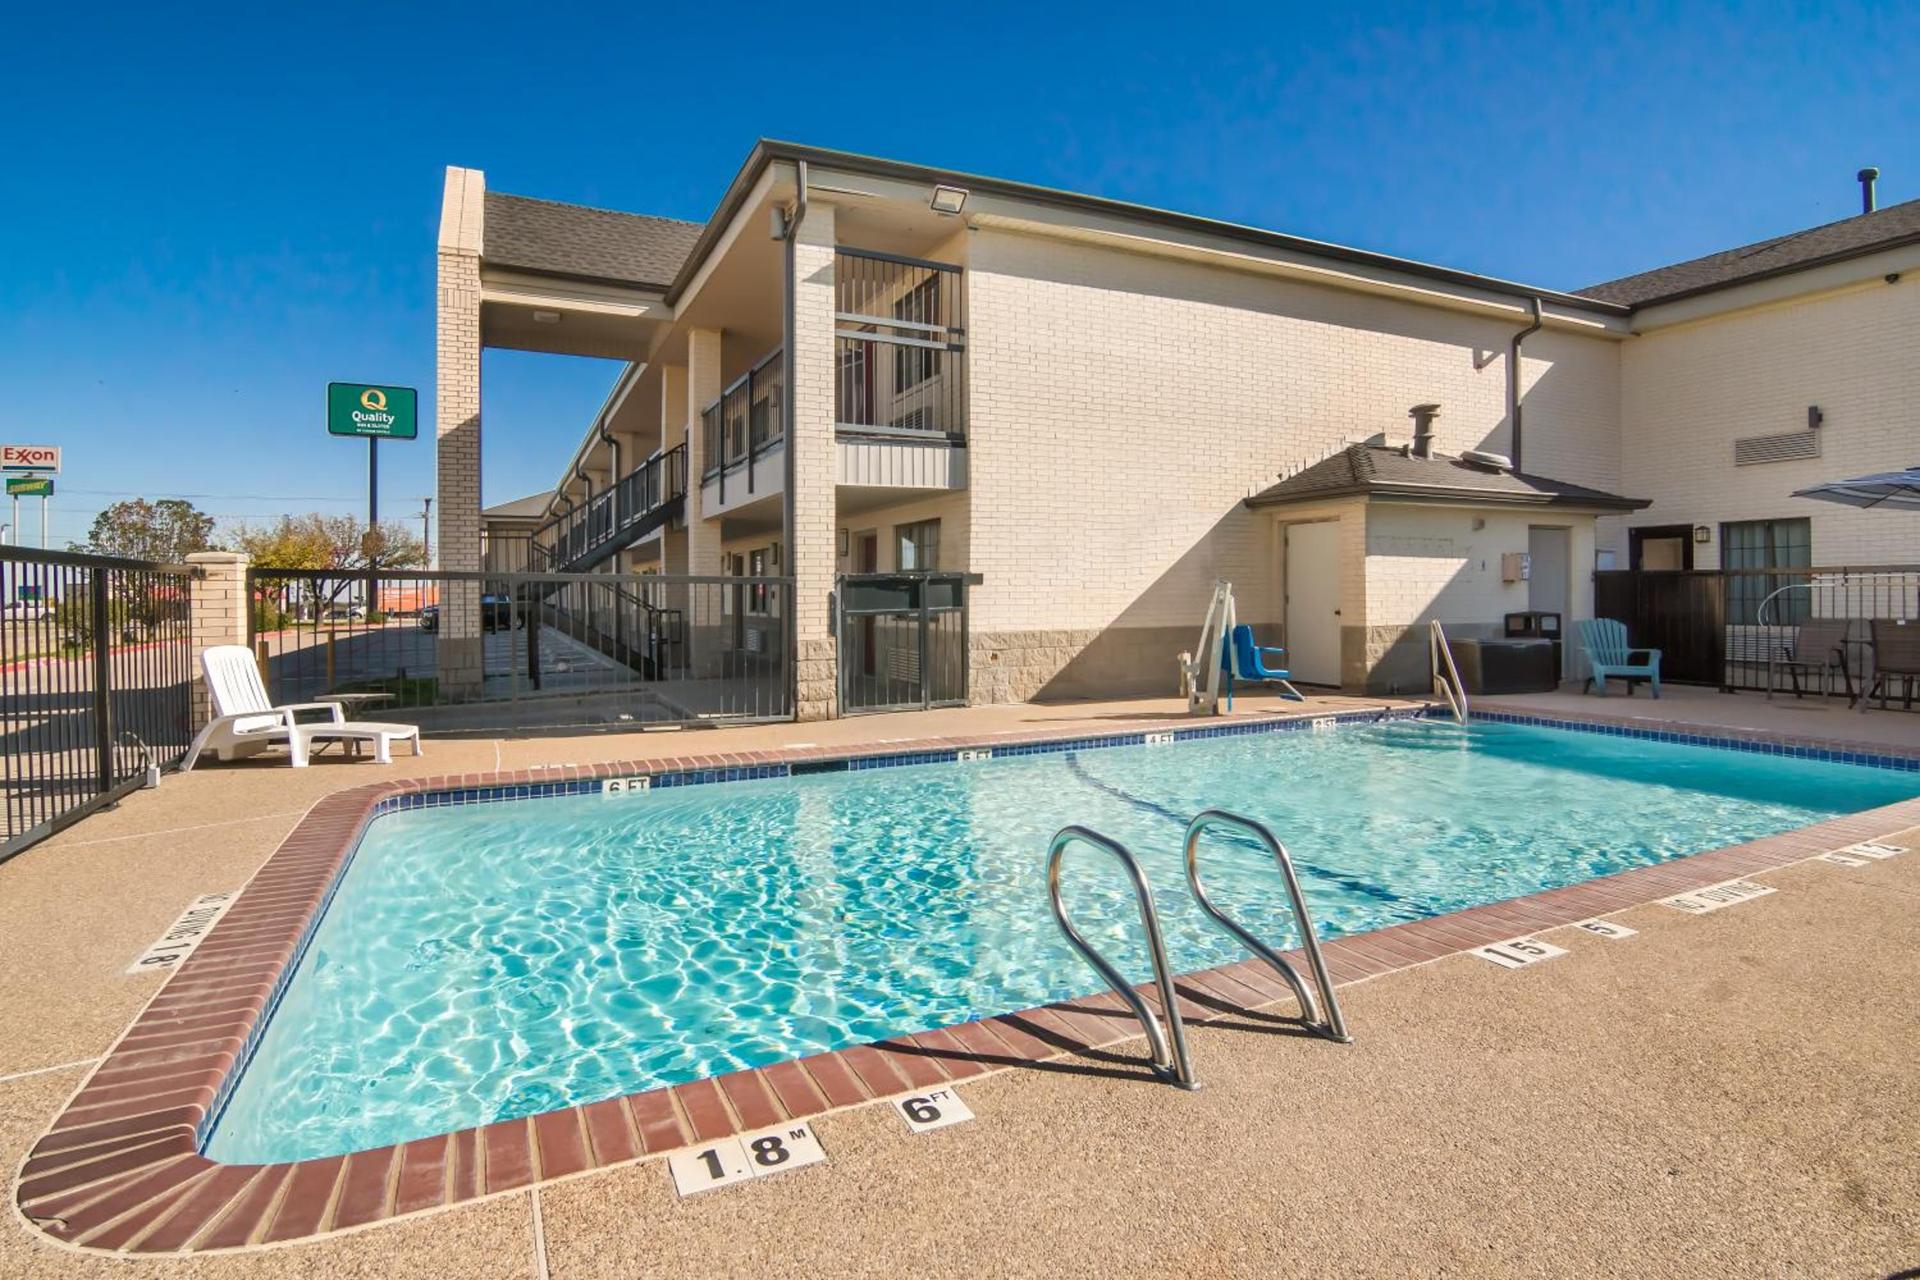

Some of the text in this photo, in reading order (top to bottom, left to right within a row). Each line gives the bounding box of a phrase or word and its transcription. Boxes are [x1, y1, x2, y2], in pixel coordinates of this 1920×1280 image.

[361, 388, 388, 411] Q
[352, 410, 395, 425] Quality
[4, 447, 54, 465] Exxon
[609, 778, 648, 792] 6 FT
[901, 1090, 951, 1124] 6 FT
[789, 1128, 807, 1141] M
